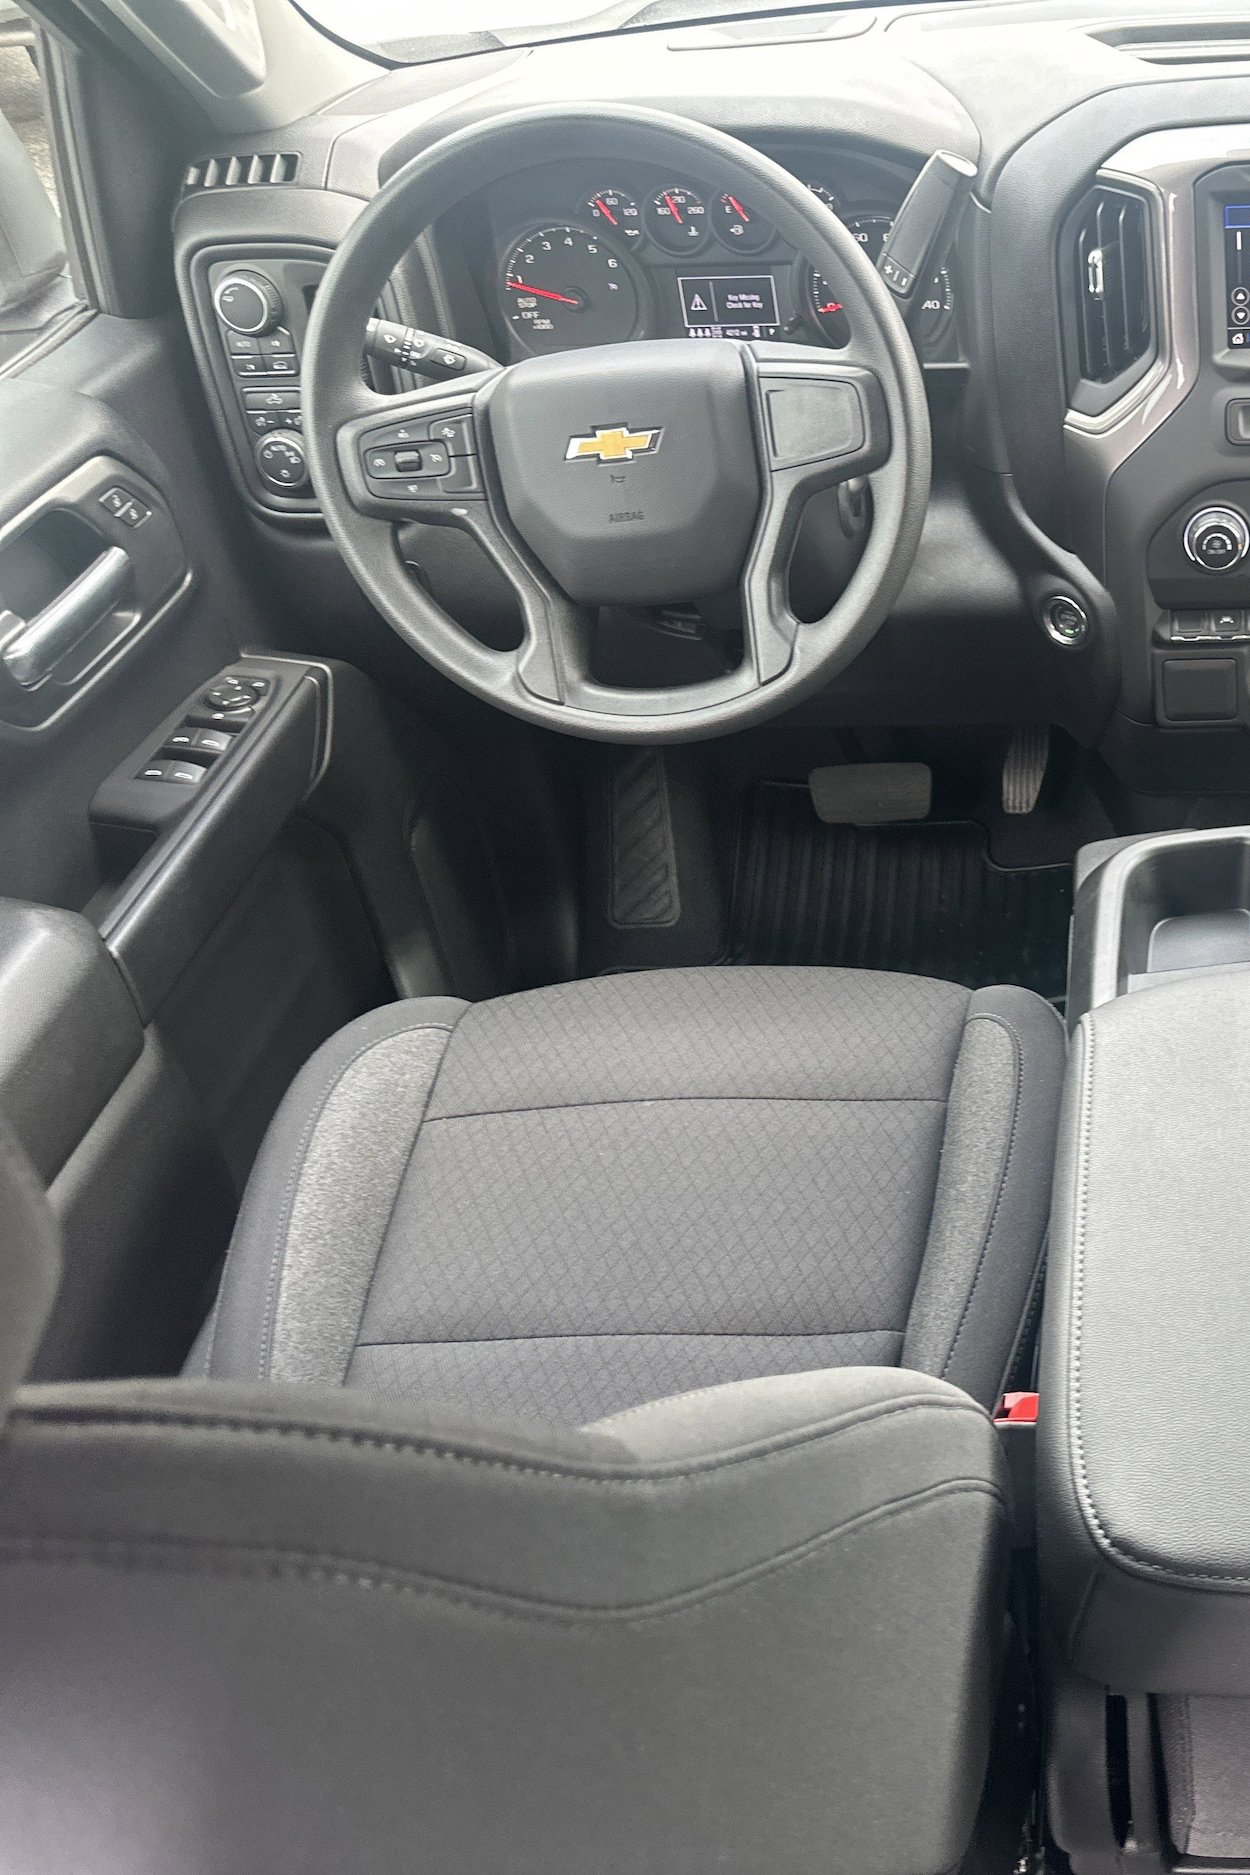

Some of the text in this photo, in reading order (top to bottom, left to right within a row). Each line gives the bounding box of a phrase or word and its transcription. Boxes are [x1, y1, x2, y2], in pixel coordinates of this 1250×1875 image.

[623, 207, 638, 216] 120
[725, 205, 732, 214] E
[542, 241, 552, 250] 3
[563, 237, 573, 246] 4
[587, 244, 598, 253] 5
[525, 254, 535, 264] 2
[607, 258, 618, 268] 6
[521, 311, 540, 319] OFF
